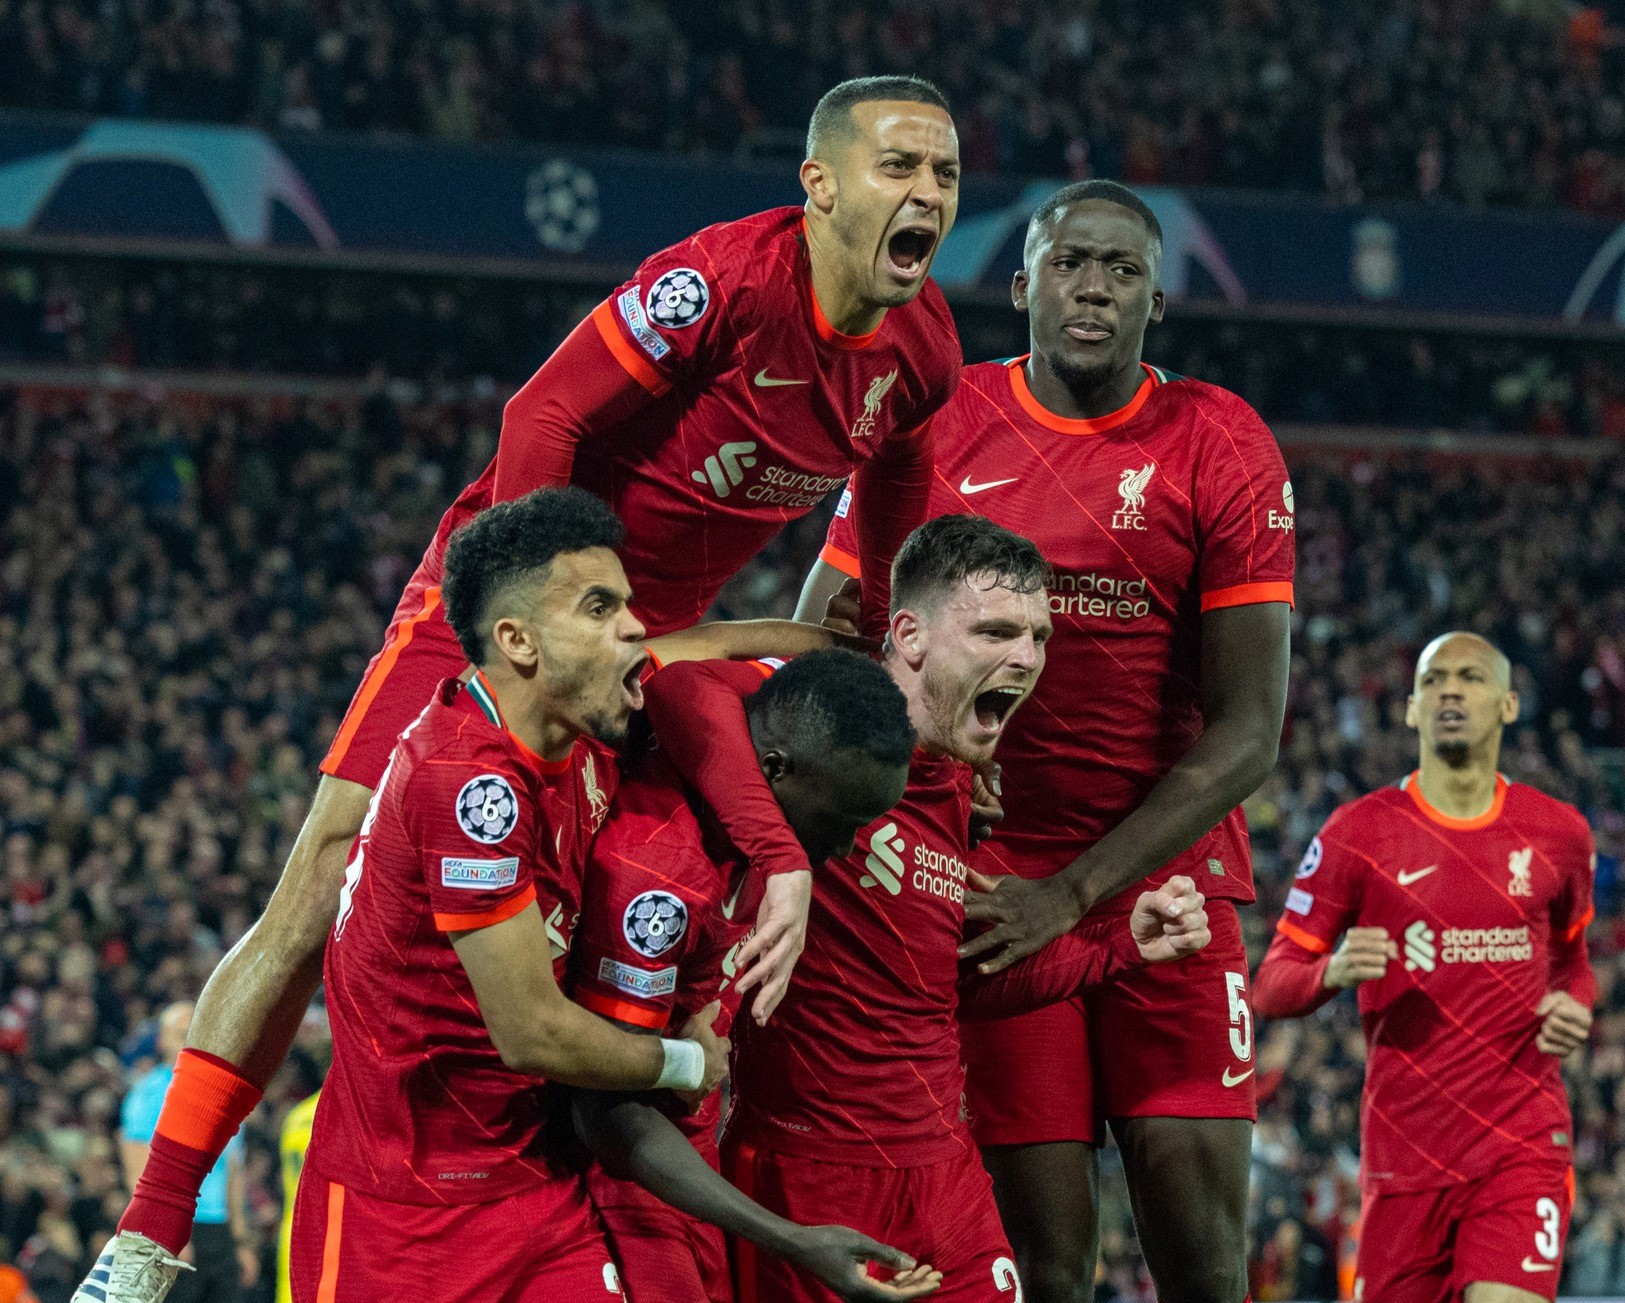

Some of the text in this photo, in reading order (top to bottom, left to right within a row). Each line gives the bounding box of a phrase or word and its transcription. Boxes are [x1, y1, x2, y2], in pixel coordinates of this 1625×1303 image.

[665, 288, 686, 308] 6
[1044, 573, 1146, 596] andard
[1048, 592, 1150, 619] artered
[482, 797, 498, 821] 6
[444, 867, 515, 879] FOUNDATION
[914, 843, 967, 884] standar
[648, 913, 665, 936] 6
[1441, 926, 1529, 946] standard
[1441, 943, 1533, 963] chartered
[602, 967, 673, 991] FOUNDATION
[1225, 972, 1251, 1062] 5
[1535, 1197, 1560, 1260] 3
